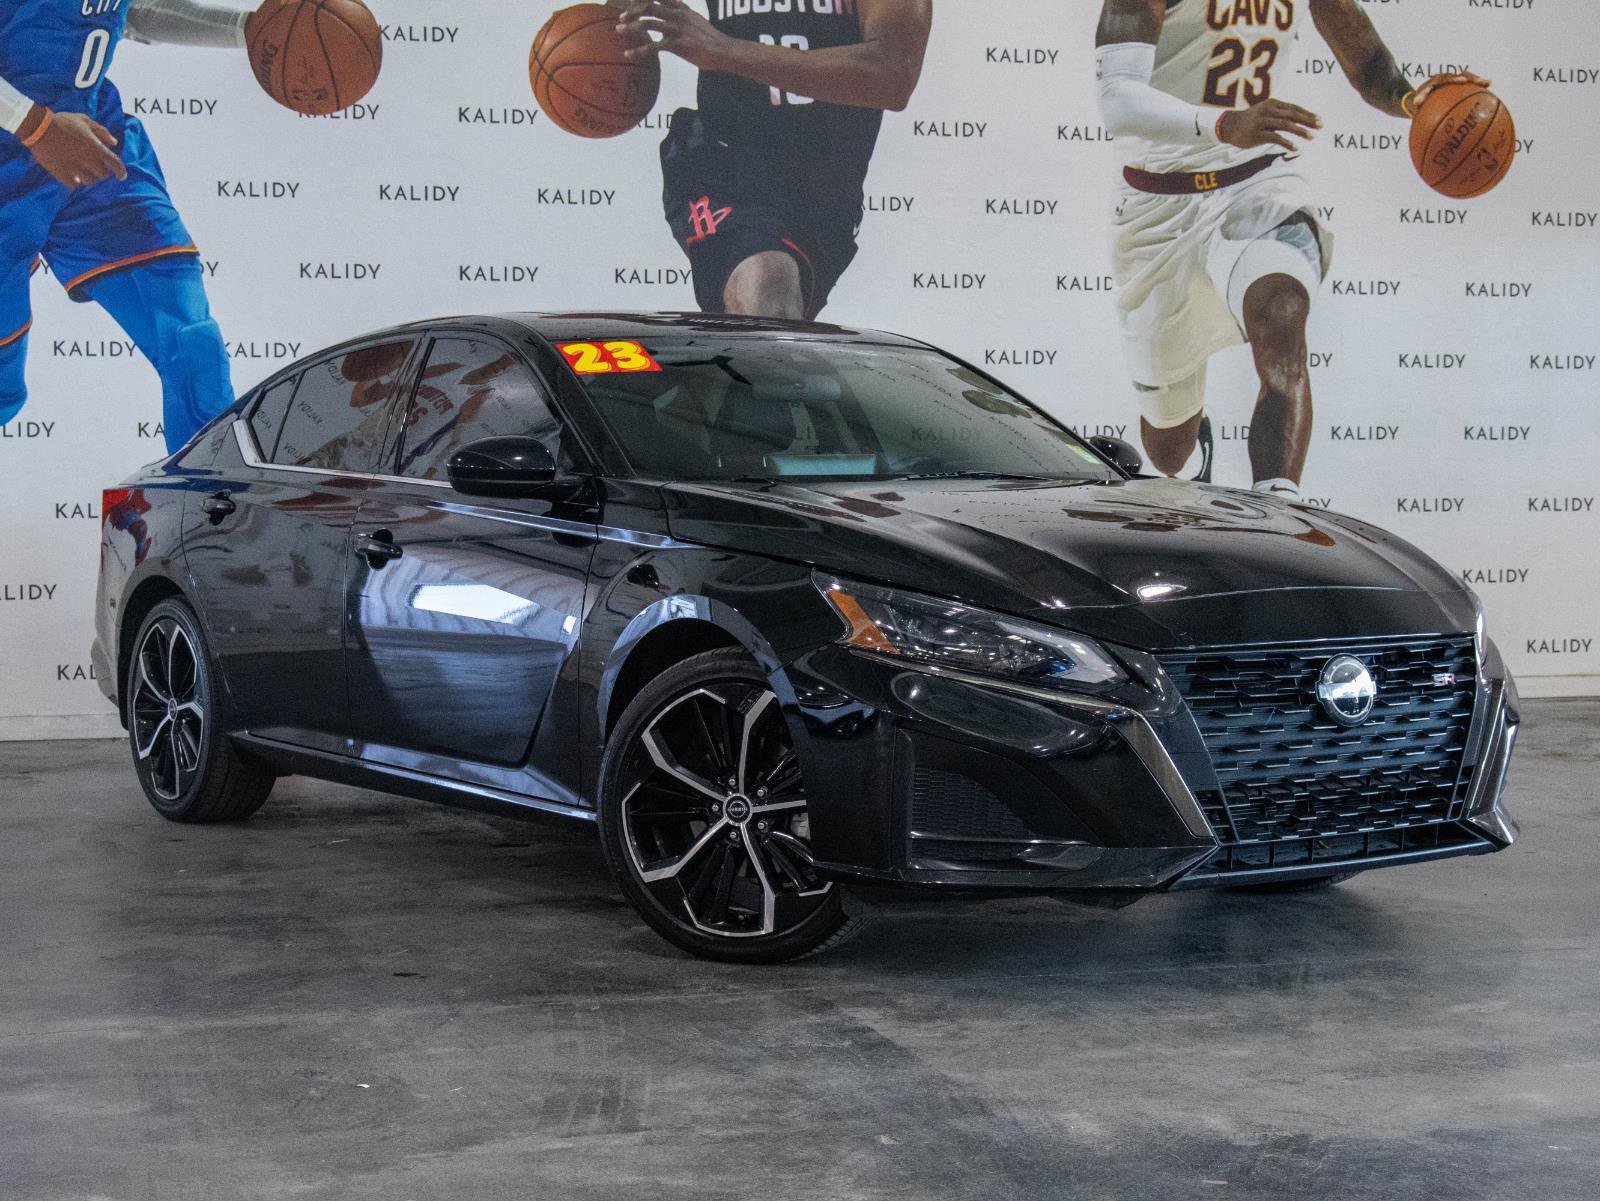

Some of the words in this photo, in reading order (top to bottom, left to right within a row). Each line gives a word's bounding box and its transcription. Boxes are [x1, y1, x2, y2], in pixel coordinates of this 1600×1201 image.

[379, 25, 459, 43] KALIDY
[74, 28, 110, 89] 0
[986, 47, 1059, 65] KALIDY
[1201, 36, 1279, 109] 23
[1296, 59, 1336, 75] IDY
[1402, 63, 1469, 79] KALIDY
[1533, 67, 1600, 84] KALIDY
[134, 98, 218, 116] KALIDY
[458, 106, 538, 125] KALIDY
[913, 120, 988, 138] KALIDY
[1334, 133, 1402, 150] KALIDY
[1194, 171, 1218, 191] CLE
[218, 181, 300, 199] KALIDY
[380, 184, 460, 202] KALIDY
[537, 188, 616, 206] KALIDY
[863, 195, 915, 212] LIDY
[985, 199, 1058, 216] KALIDY
[1400, 208, 1468, 224] KALIDY
[1531, 211, 1598, 227] KALIDY
[299, 262, 381, 280] KALIDY
[460, 265, 539, 283] KALIDY
[615, 268, 691, 286] KALIDY
[913, 272, 986, 289] KALIDY
[1056, 275, 1113, 291] KALID
[1332, 280, 1401, 296] KALIDY
[1465, 282, 1532, 298] KALIDY
[53, 340, 136, 357] KALIDY
[562, 341, 652, 373] 23
[985, 349, 1057, 365] KALIDY
[1398, 353, 1466, 369] KALIDY
[1529, 355, 1596, 370] KALIDY
[2, 421, 56, 438] LIDY
[1072, 424, 1127, 440] ALIDY
[1331, 425, 1399, 441] KALIDY
[1464, 425, 1531, 441] KALIDY
[55, 503, 99, 519] KAL
[1397, 497, 1465, 513] KALIDY
[1528, 497, 1594, 512] KALIDY
[1463, 568, 1529, 584] KALIDY
[0, 583, 58, 600] LIDY
[1526, 638, 1593, 654] KALIDY
[57, 664, 98, 681] KAL
